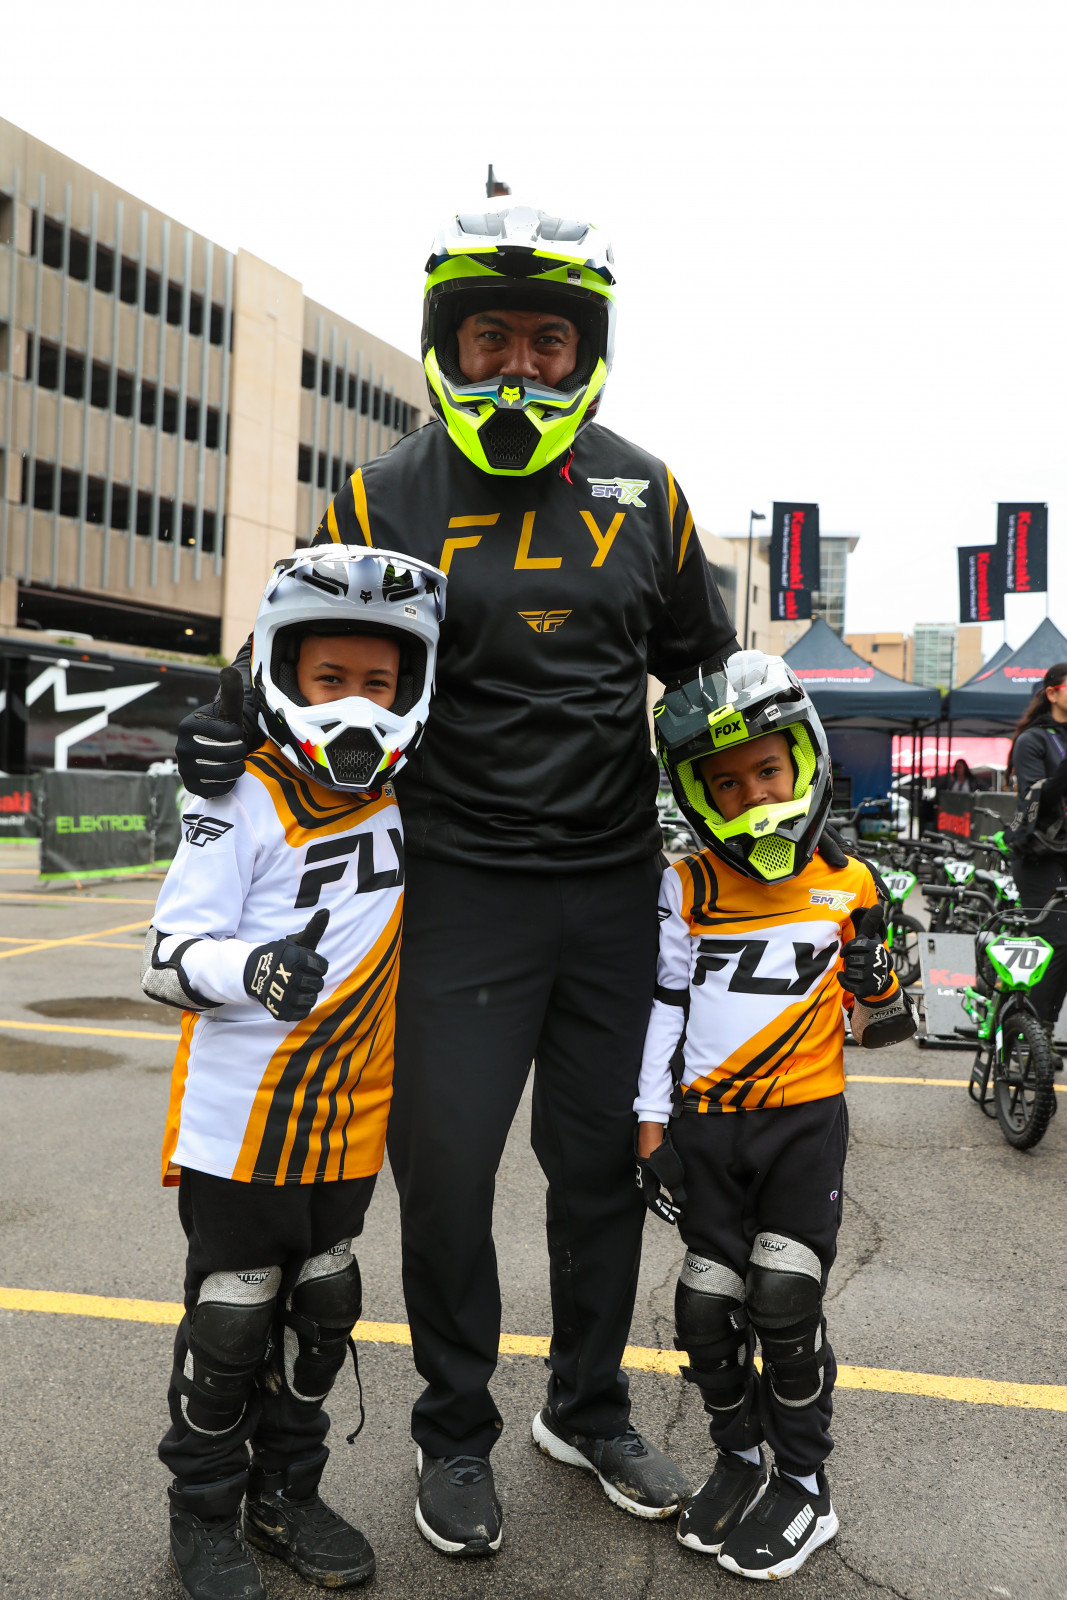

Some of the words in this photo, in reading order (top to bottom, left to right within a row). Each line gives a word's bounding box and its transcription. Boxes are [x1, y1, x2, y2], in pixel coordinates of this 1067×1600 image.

[591, 477, 650, 508] SMX
[437, 510, 626, 577] FLY
[789, 511, 805, 590] Kawasaki
[1015, 510, 1032, 592] Kawasaki
[977, 552, 991, 621] Kawasaki
[714, 719, 742, 739] FOX
[56, 814, 147, 834] ELEKTRODE
[889, 878, 907, 890] 10
[808, 888, 856, 913] SMX
[691, 938, 840, 996] FLY
[1004, 947, 1040, 969] 70
[265, 962, 292, 1016] FOX
[760, 1238, 788, 1250] TITAN
[236, 1272, 270, 1281] TITAN
[782, 1503, 815, 1547] PUMA
